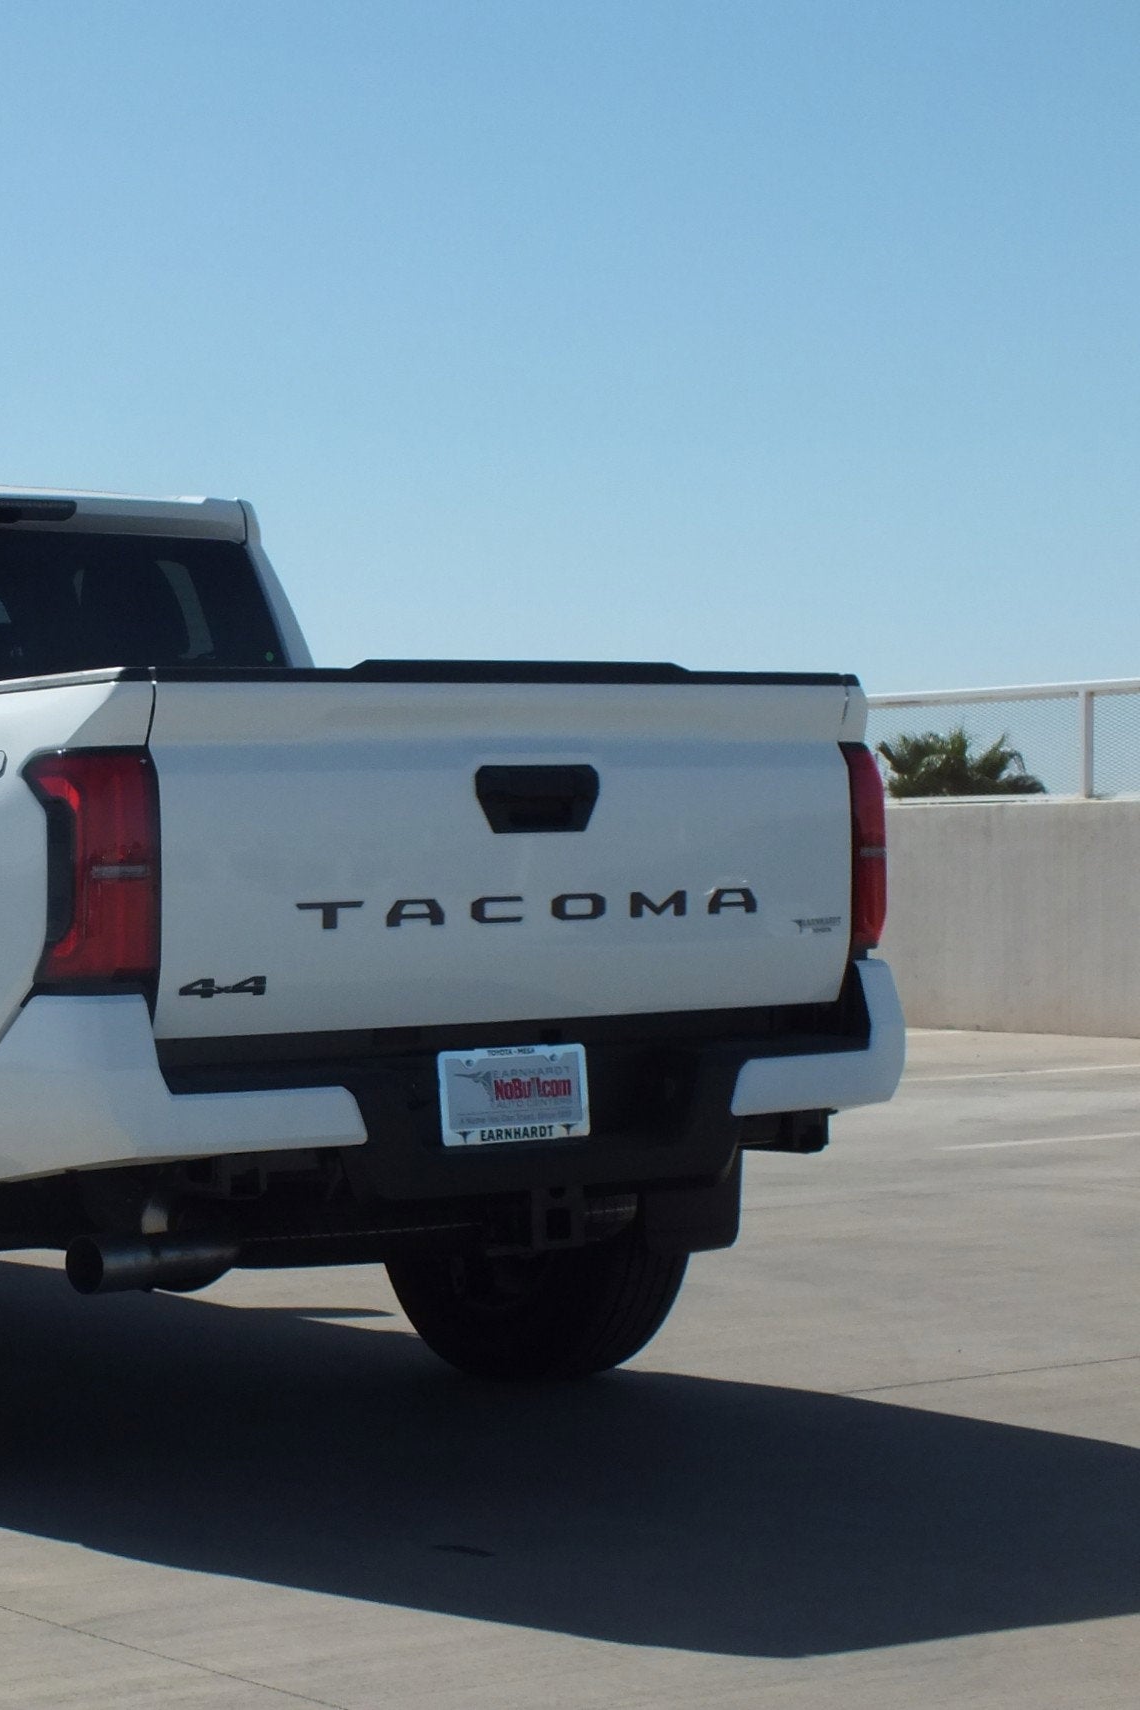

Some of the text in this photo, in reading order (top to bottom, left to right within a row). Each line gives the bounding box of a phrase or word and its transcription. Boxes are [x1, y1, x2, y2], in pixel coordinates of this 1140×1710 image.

[296, 886, 760, 931] TACOMA
[487, 1048, 513, 1056] TOYOTA
[493, 1066, 571, 1079] EARNHARDT
[480, 1125, 554, 1142] EARNHARDT
